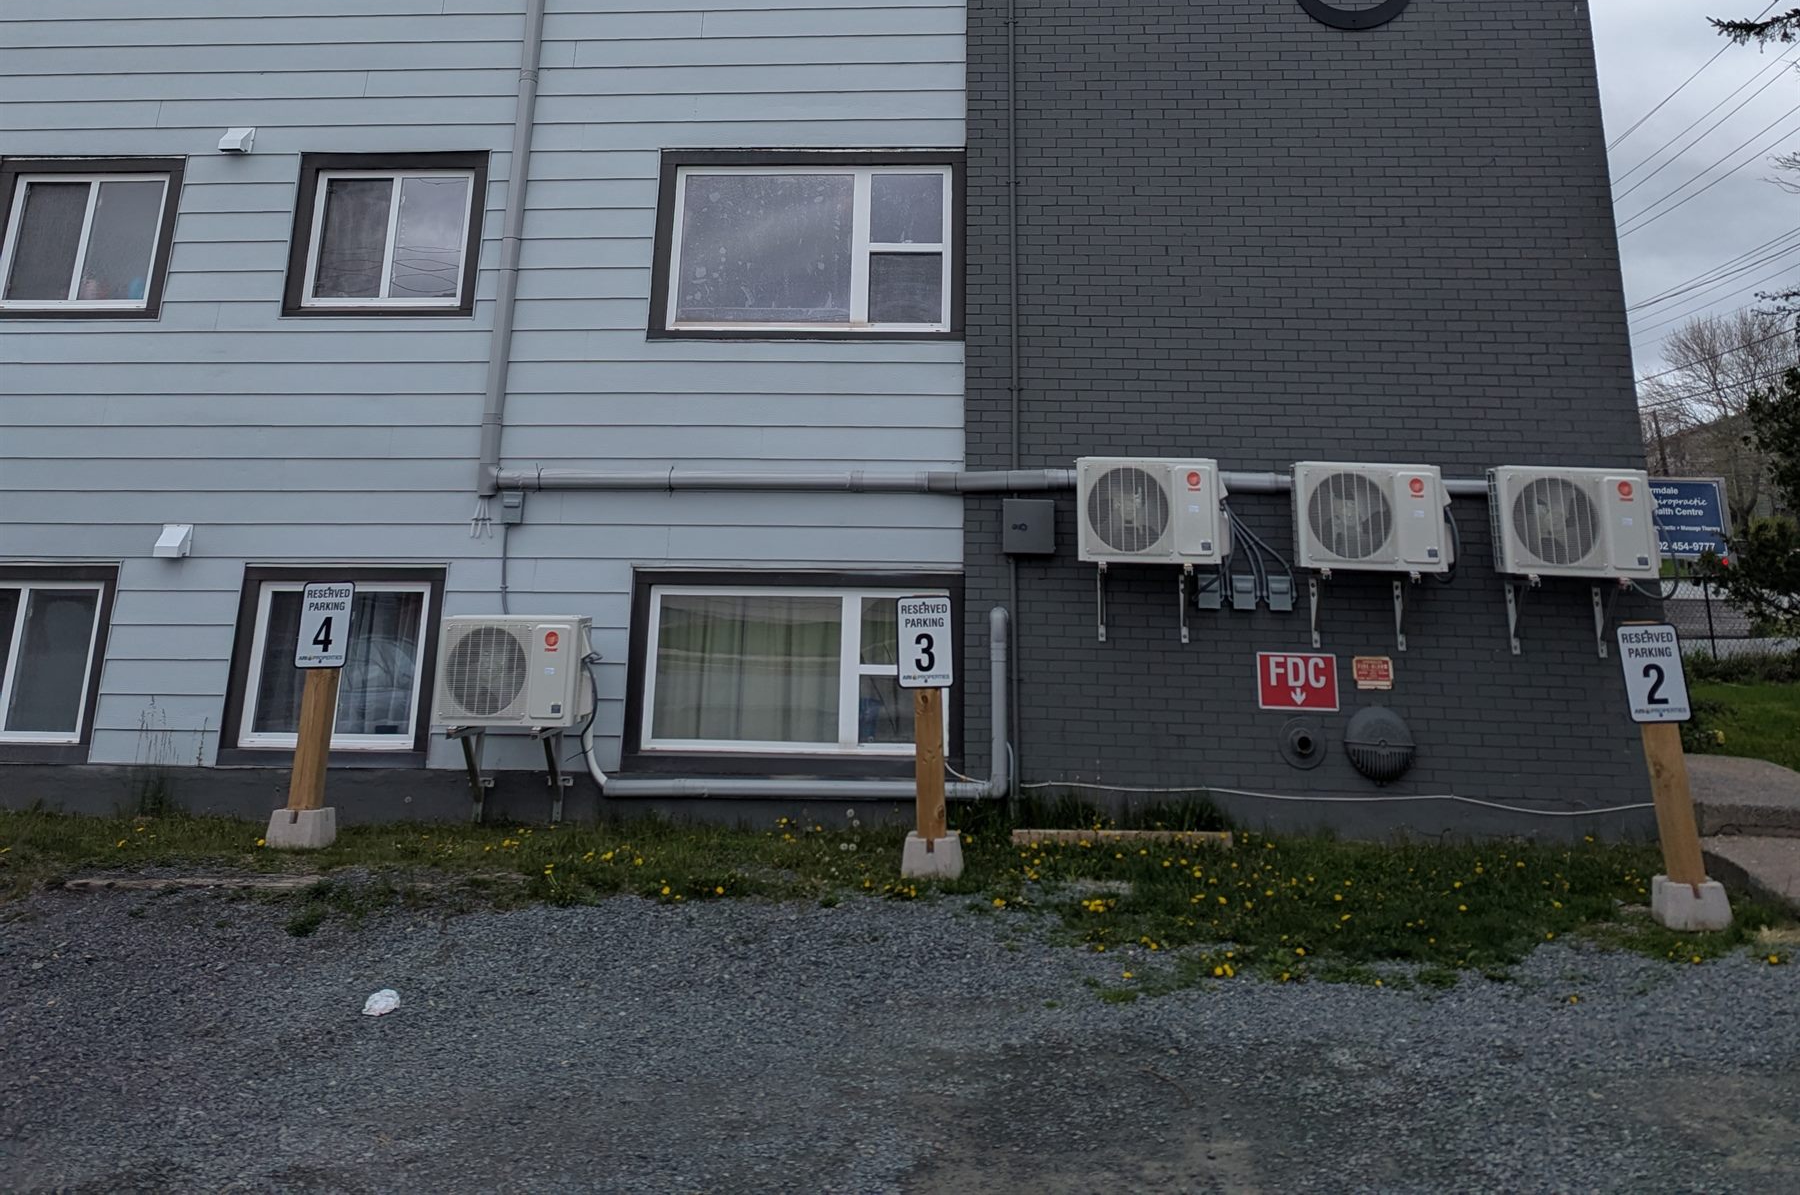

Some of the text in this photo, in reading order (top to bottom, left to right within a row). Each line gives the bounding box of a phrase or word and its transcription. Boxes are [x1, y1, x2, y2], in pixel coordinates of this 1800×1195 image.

[1650, 487, 1679, 495] rmdale
[1657, 496, 1708, 507] iropractic
[1675, 507, 1704, 516] Centre
[1672, 541, 1716, 551] 454-9777
[307, 588, 351, 599] RESERVED
[308, 601, 346, 612] PARKING
[901, 604, 948, 615] RESERVED
[904, 617, 945, 628] PARKING
[312, 616, 333, 653] 4
[1621, 632, 1674, 644] RESERVED
[914, 633, 935, 672] 3
[1627, 646, 1673, 659] PARKING
[1268, 656, 1327, 689] FDC
[1642, 663, 1670, 705] 2
